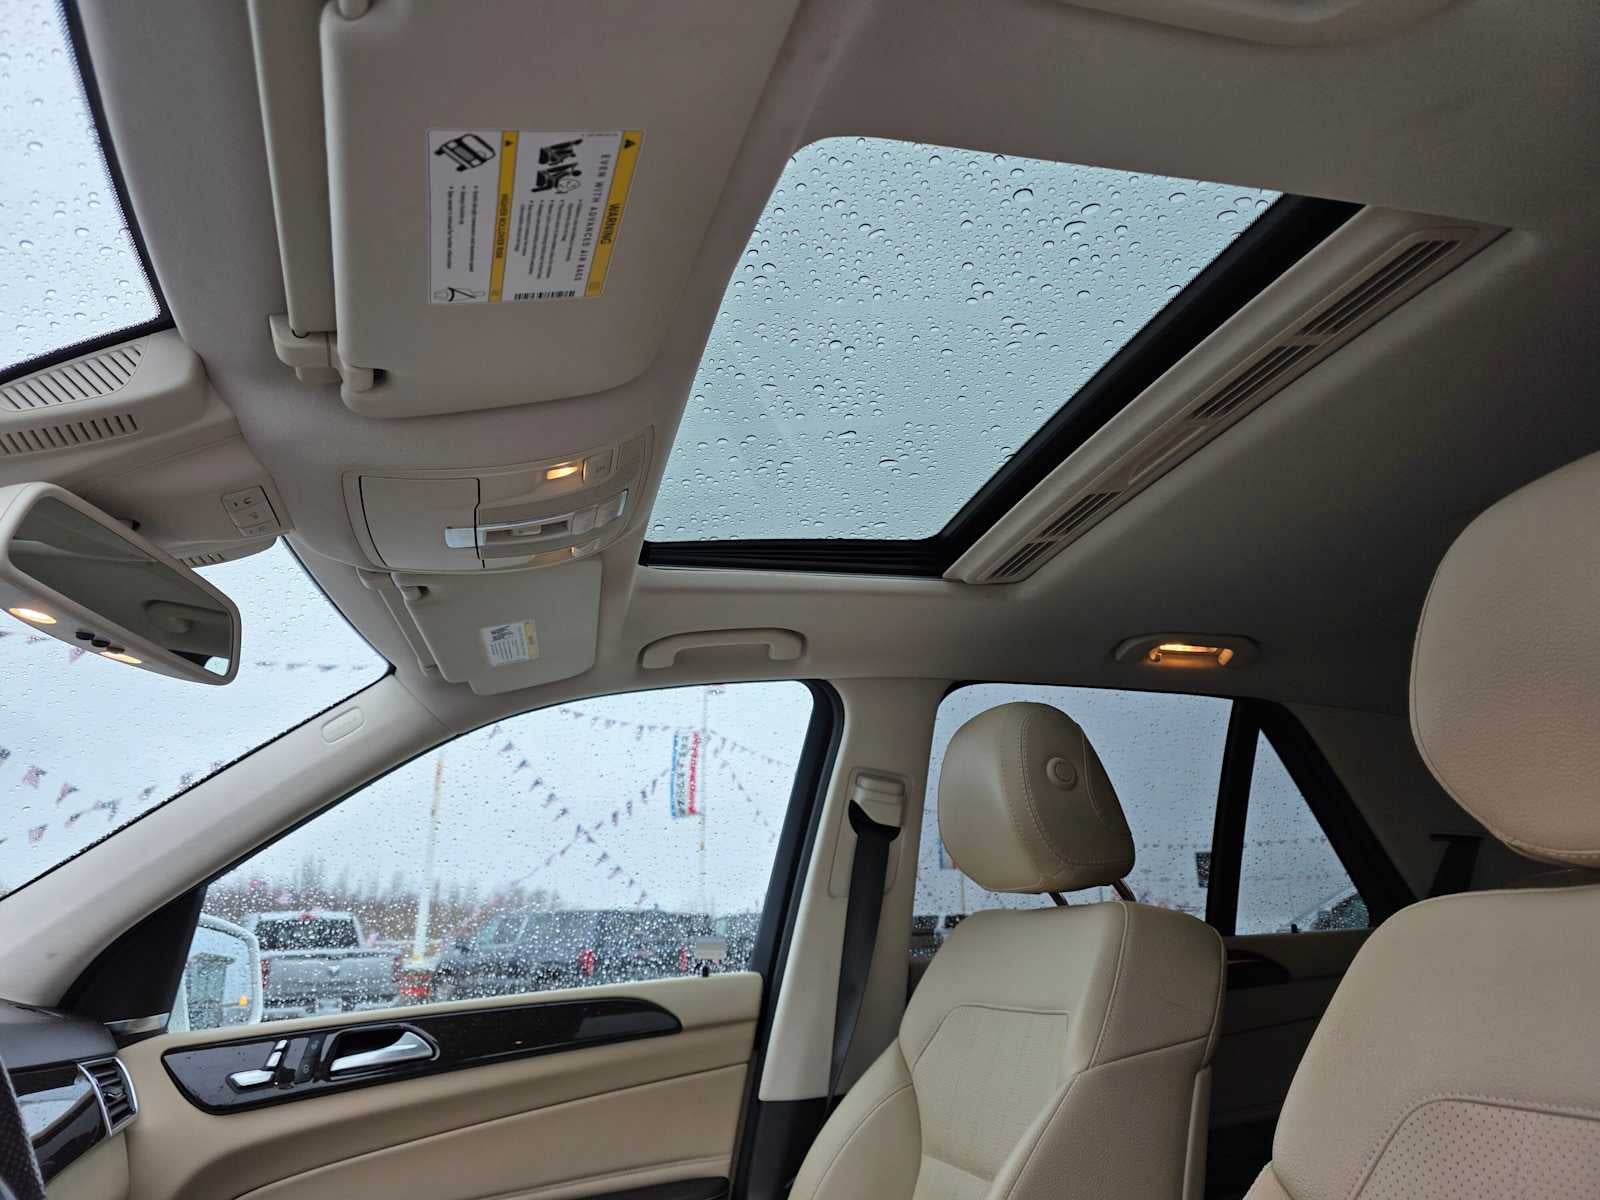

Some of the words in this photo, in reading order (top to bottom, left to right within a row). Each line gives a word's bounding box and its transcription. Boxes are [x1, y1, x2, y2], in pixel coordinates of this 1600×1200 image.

[597, 154, 611, 178] EVEN
[592, 181, 604, 203] WITH
[581, 206, 598, 247] ADVANCED
[600, 204, 622, 245] WARNING
[579, 250, 589, 262] AIR
[574, 264, 586, 282] BAGS
